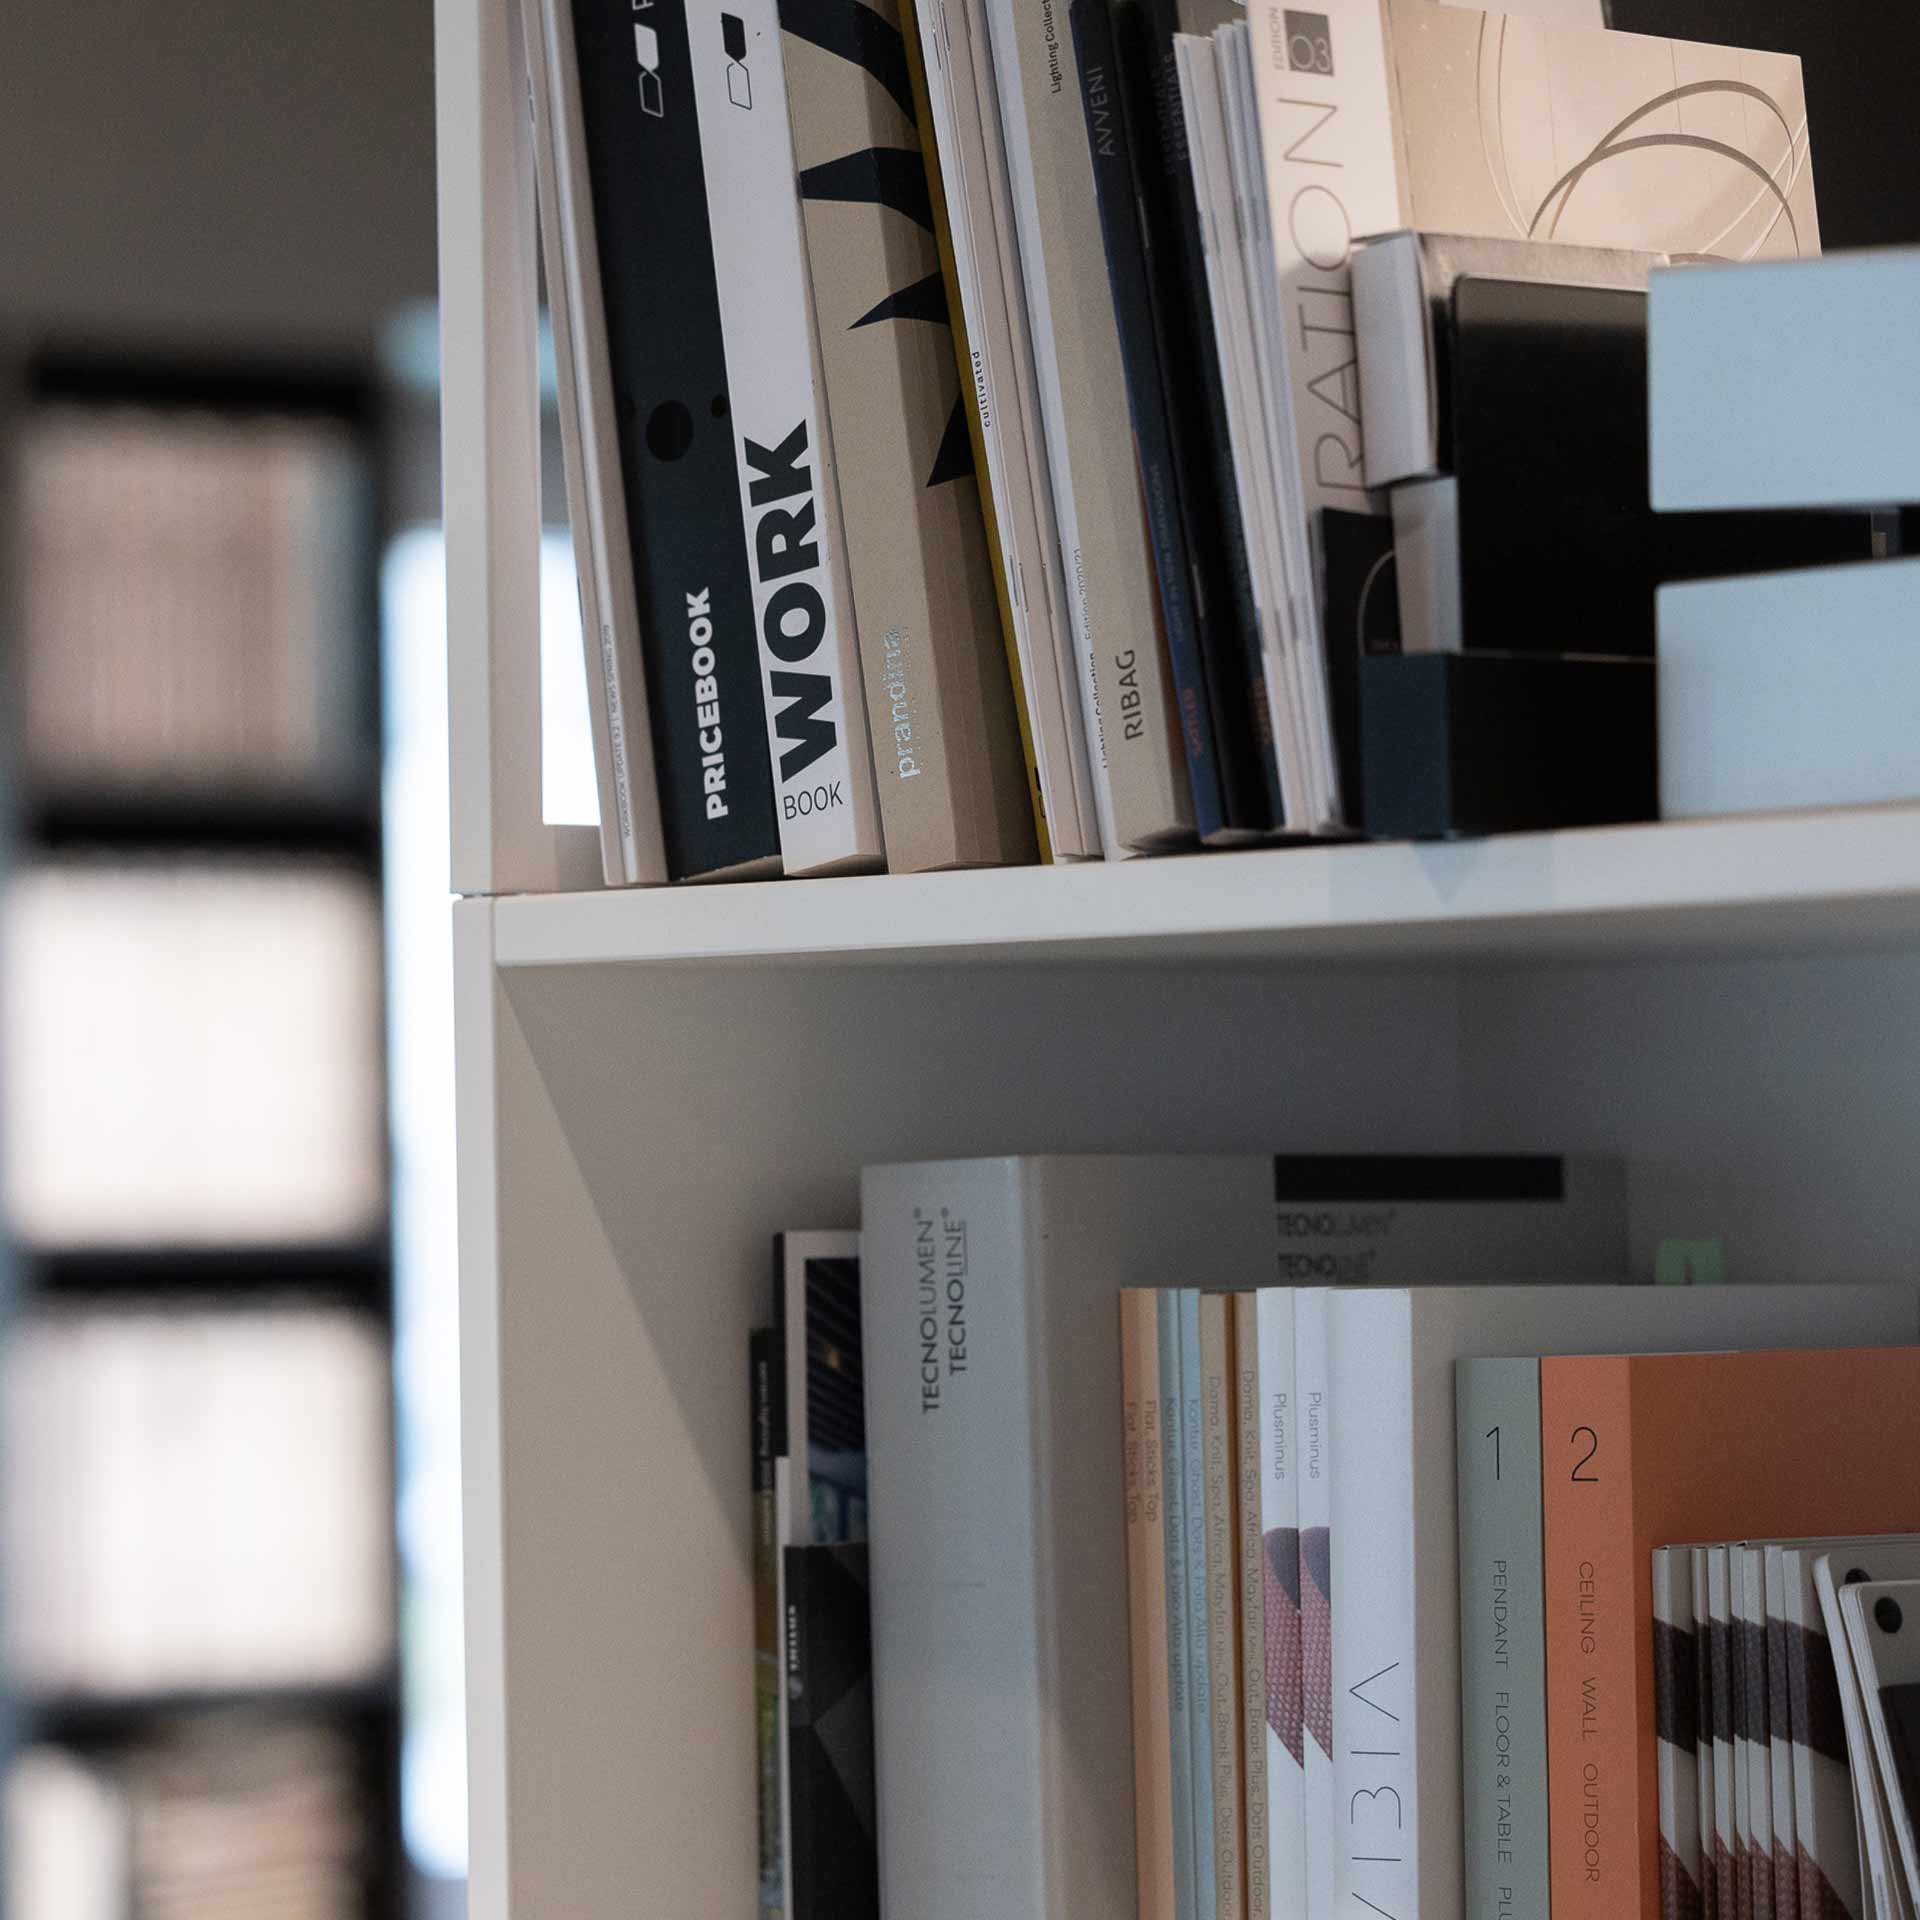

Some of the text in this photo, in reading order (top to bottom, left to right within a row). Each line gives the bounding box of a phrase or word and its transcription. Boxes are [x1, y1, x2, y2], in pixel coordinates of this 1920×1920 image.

[1048, 42, 1062, 94] Lighting
[972, 351, 990, 427] cultivated
[744, 419, 838, 784] WORK
[686, 586, 729, 821] PRICEBOOK
[1115, 649, 1144, 741] RIBAG
[783, 781, 843, 820] BOOK
[1273, 1393, 1287, 1481] Plusminus
[1309, 1391, 1323, 1479] Plusminus
[1486, 1426, 1500, 1481] 1
[1570, 1426, 1599, 1482] 2
[1492, 1560, 1508, 1670] PENDANT
[1495, 1692, 1510, 1772] FLOOR
[1578, 1561, 1600, 1883] CEILING WALL OUTDOOR
[1496, 1774, 1511, 1789] &
[1497, 1791, 1513, 1864] TABLE
